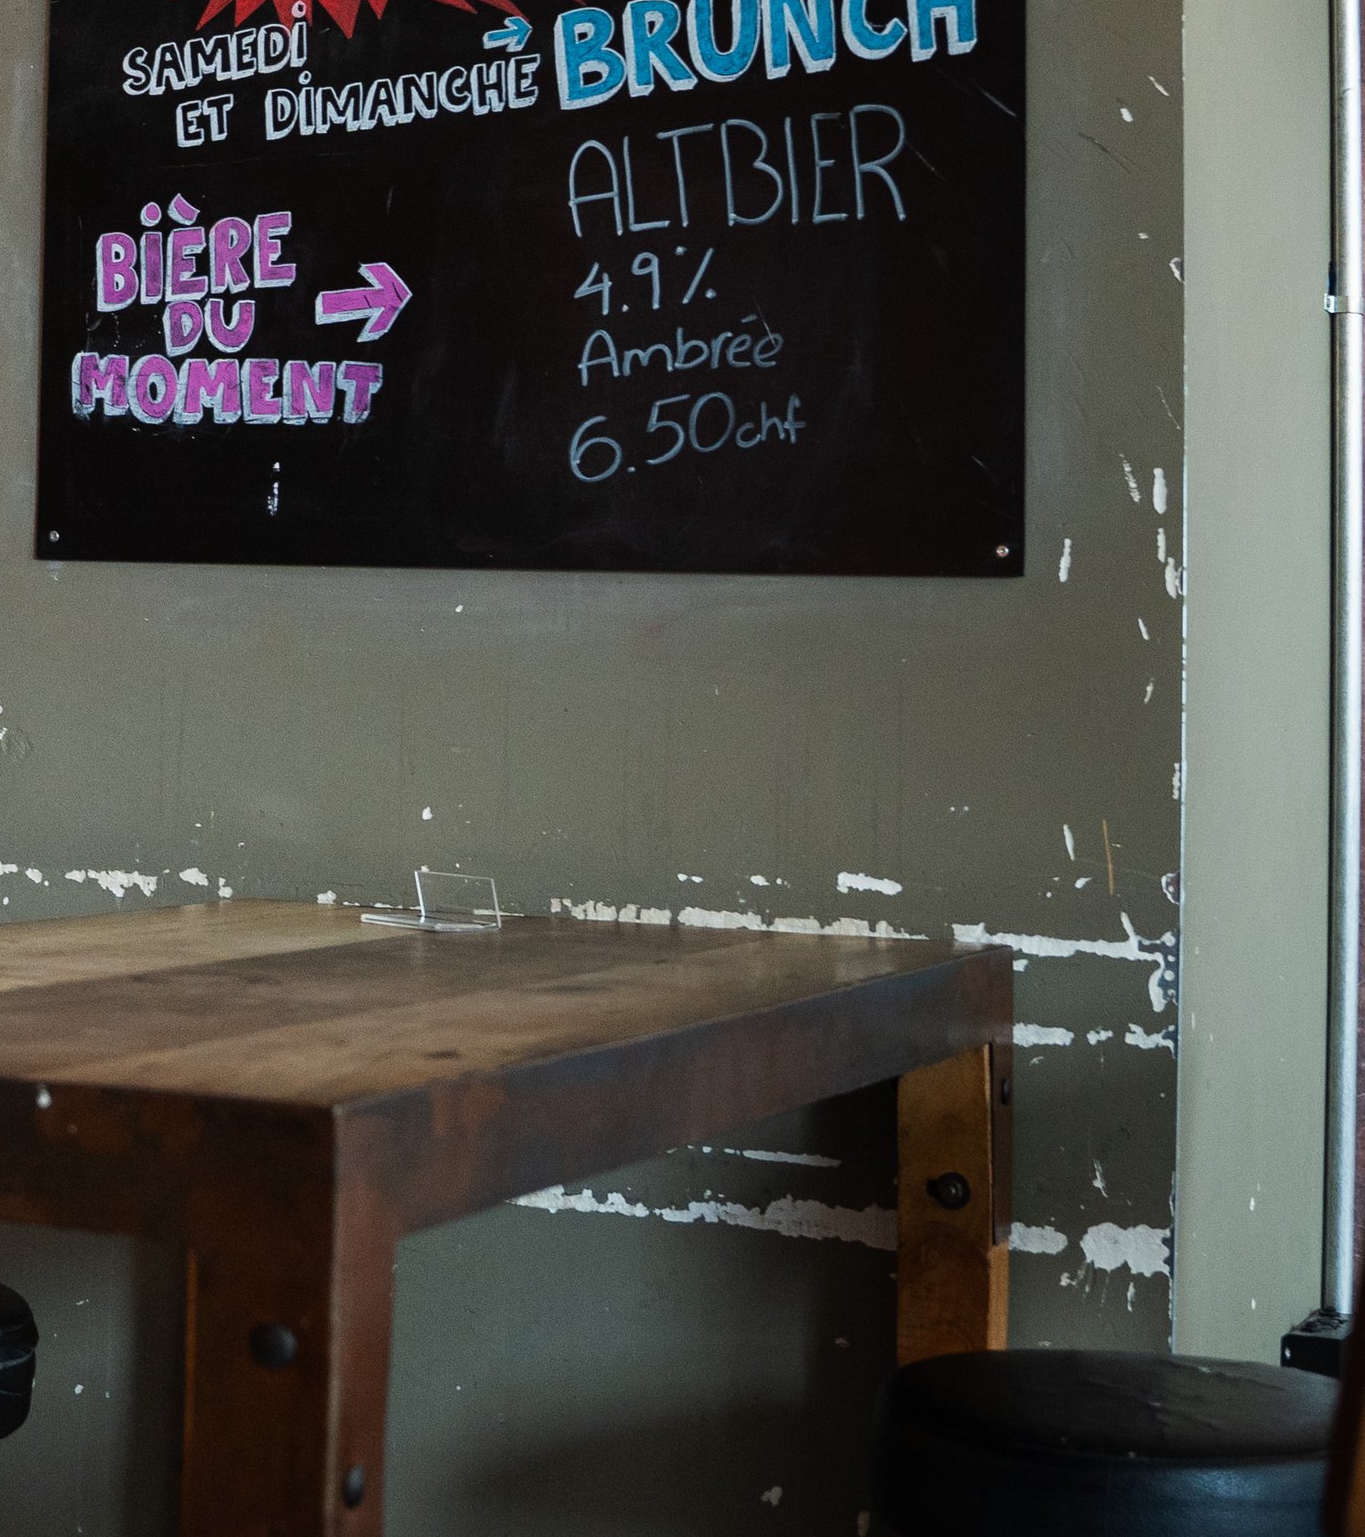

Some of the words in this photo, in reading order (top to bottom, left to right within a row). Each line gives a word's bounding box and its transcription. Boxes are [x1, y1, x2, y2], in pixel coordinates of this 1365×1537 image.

[175, 92, 234, 146] ET
[163, 297, 256, 358] DU
[577, 313, 785, 387] Ambrée
[72, 351, 384, 425] MOMENT
